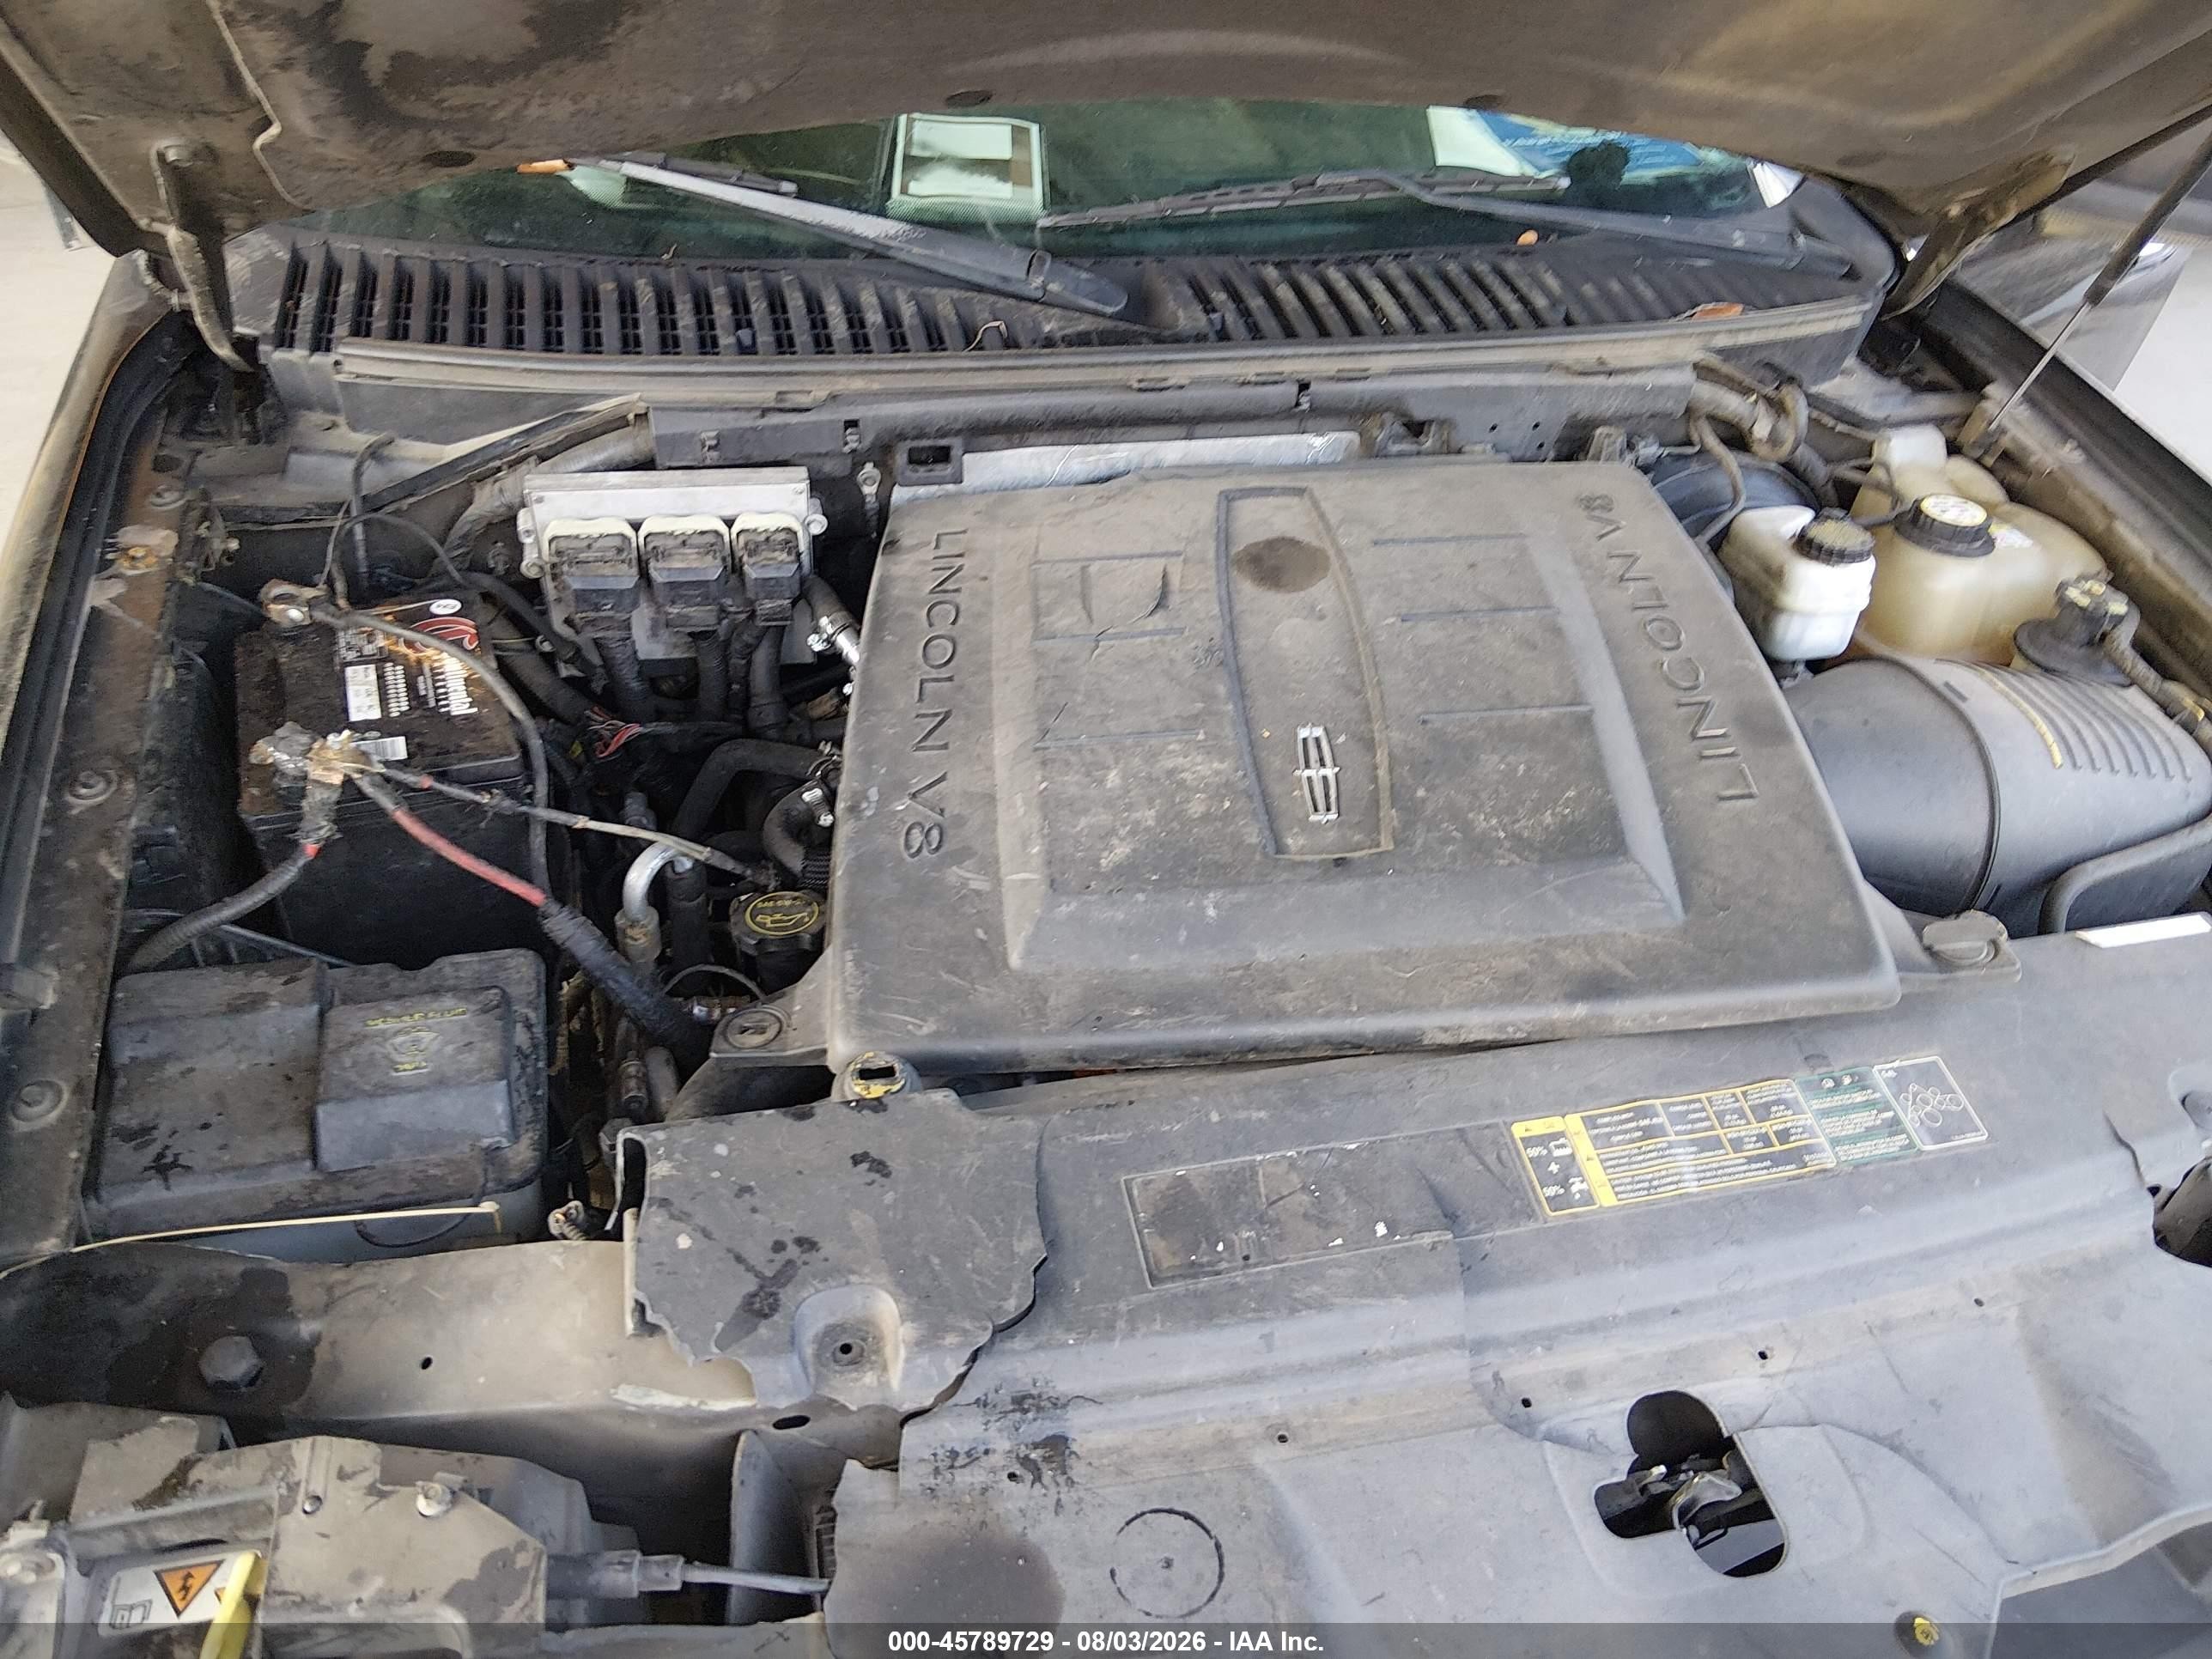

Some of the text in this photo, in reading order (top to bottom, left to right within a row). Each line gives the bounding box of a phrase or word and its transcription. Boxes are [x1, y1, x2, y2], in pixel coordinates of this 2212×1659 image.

[903, 528, 969, 860] LINCOLN V8
[1577, 493, 1759, 801] LINCOLN V8
